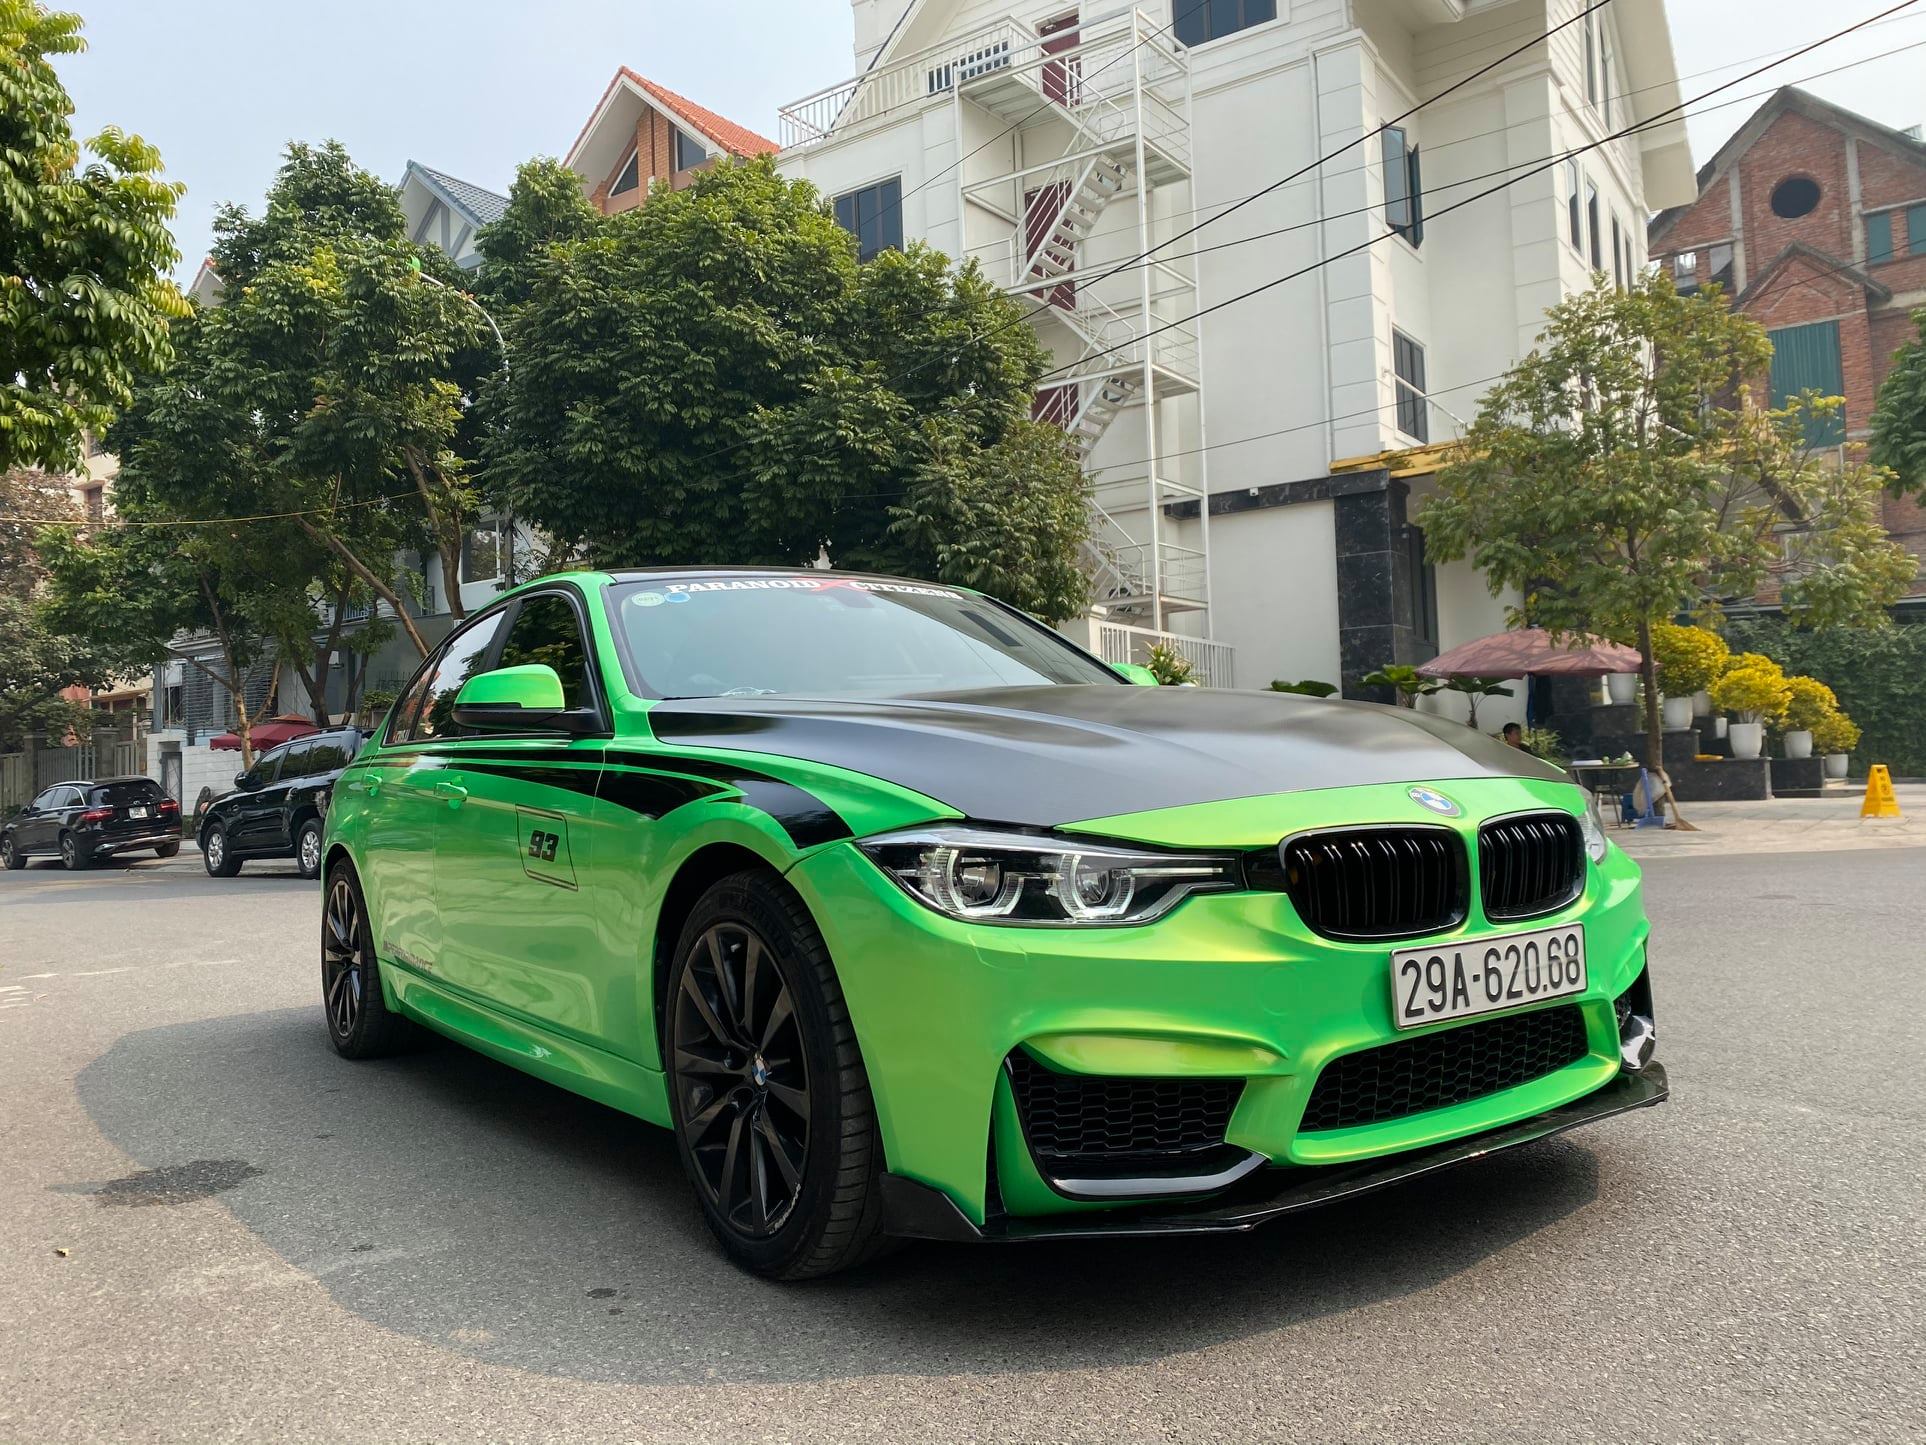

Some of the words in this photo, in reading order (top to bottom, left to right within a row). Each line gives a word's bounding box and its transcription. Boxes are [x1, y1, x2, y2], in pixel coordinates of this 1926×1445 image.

[665, 580, 821, 594] PARANOID
[528, 829, 560, 863] 93
[1401, 933, 1580, 1018] 29A-620.68
